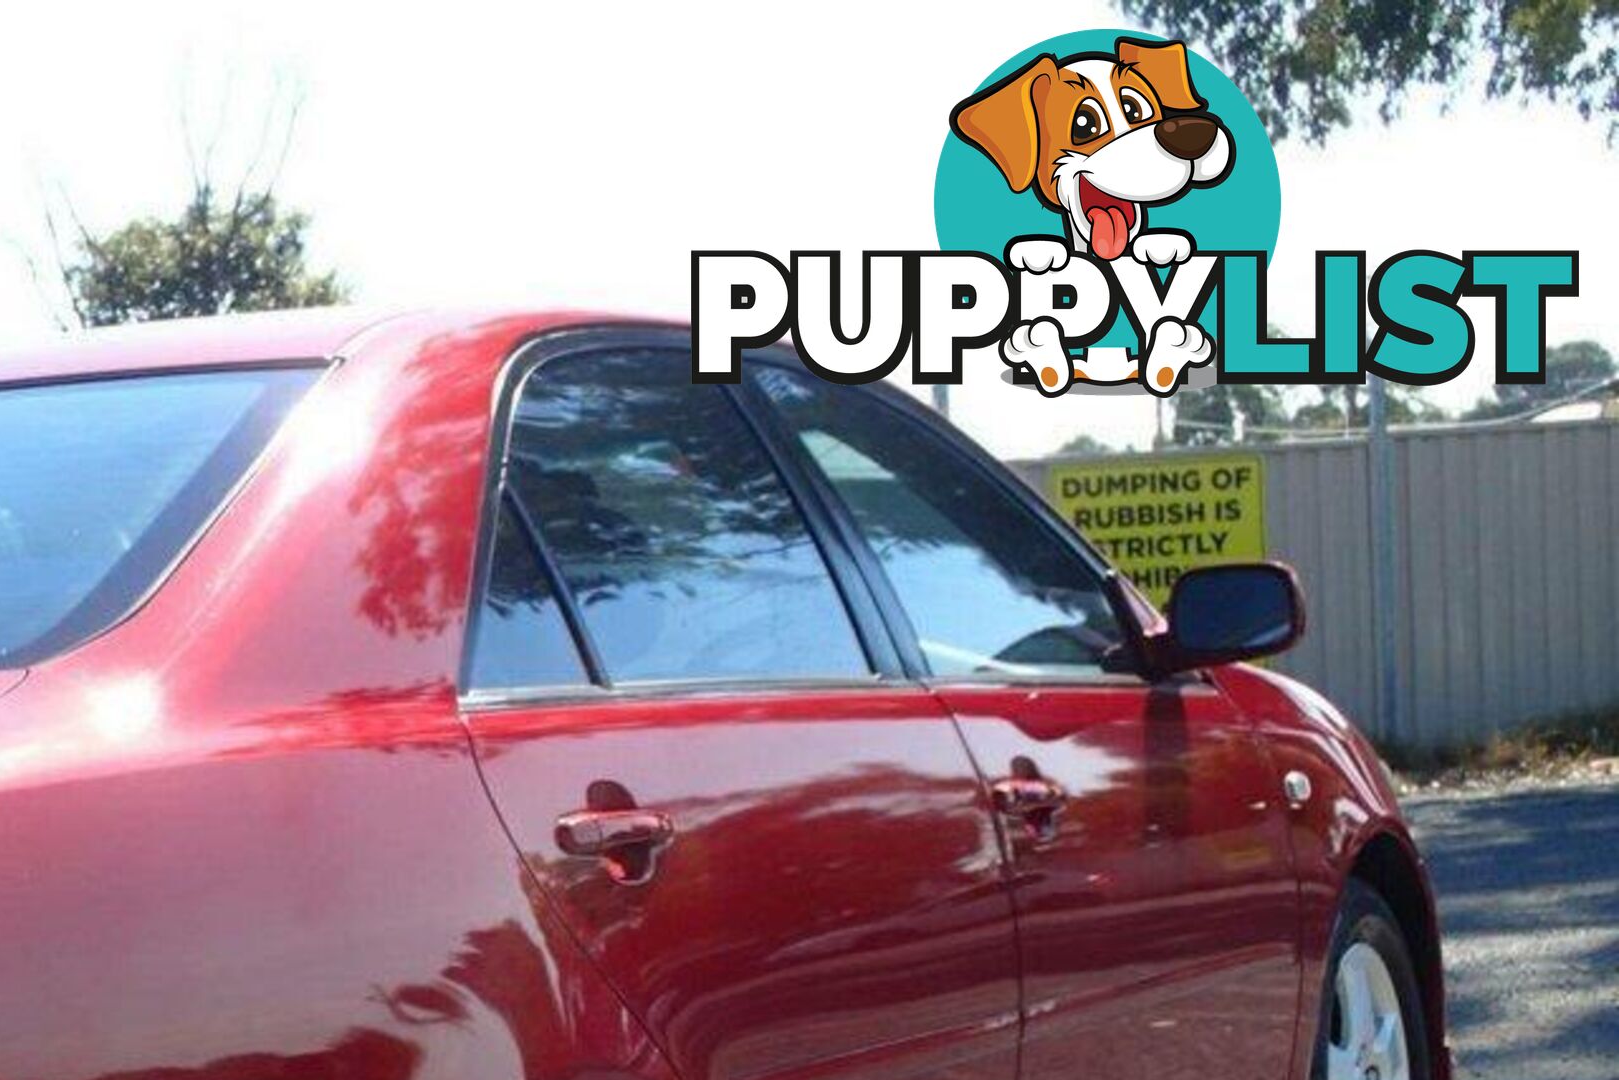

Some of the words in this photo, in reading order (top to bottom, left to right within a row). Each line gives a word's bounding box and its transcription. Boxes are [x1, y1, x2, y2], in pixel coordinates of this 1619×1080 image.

[1061, 470, 1201, 498] DUMPING
[1211, 467, 1251, 490] OF
[1074, 503, 1205, 529] RUBBISH
[1215, 500, 1241, 521] IS
